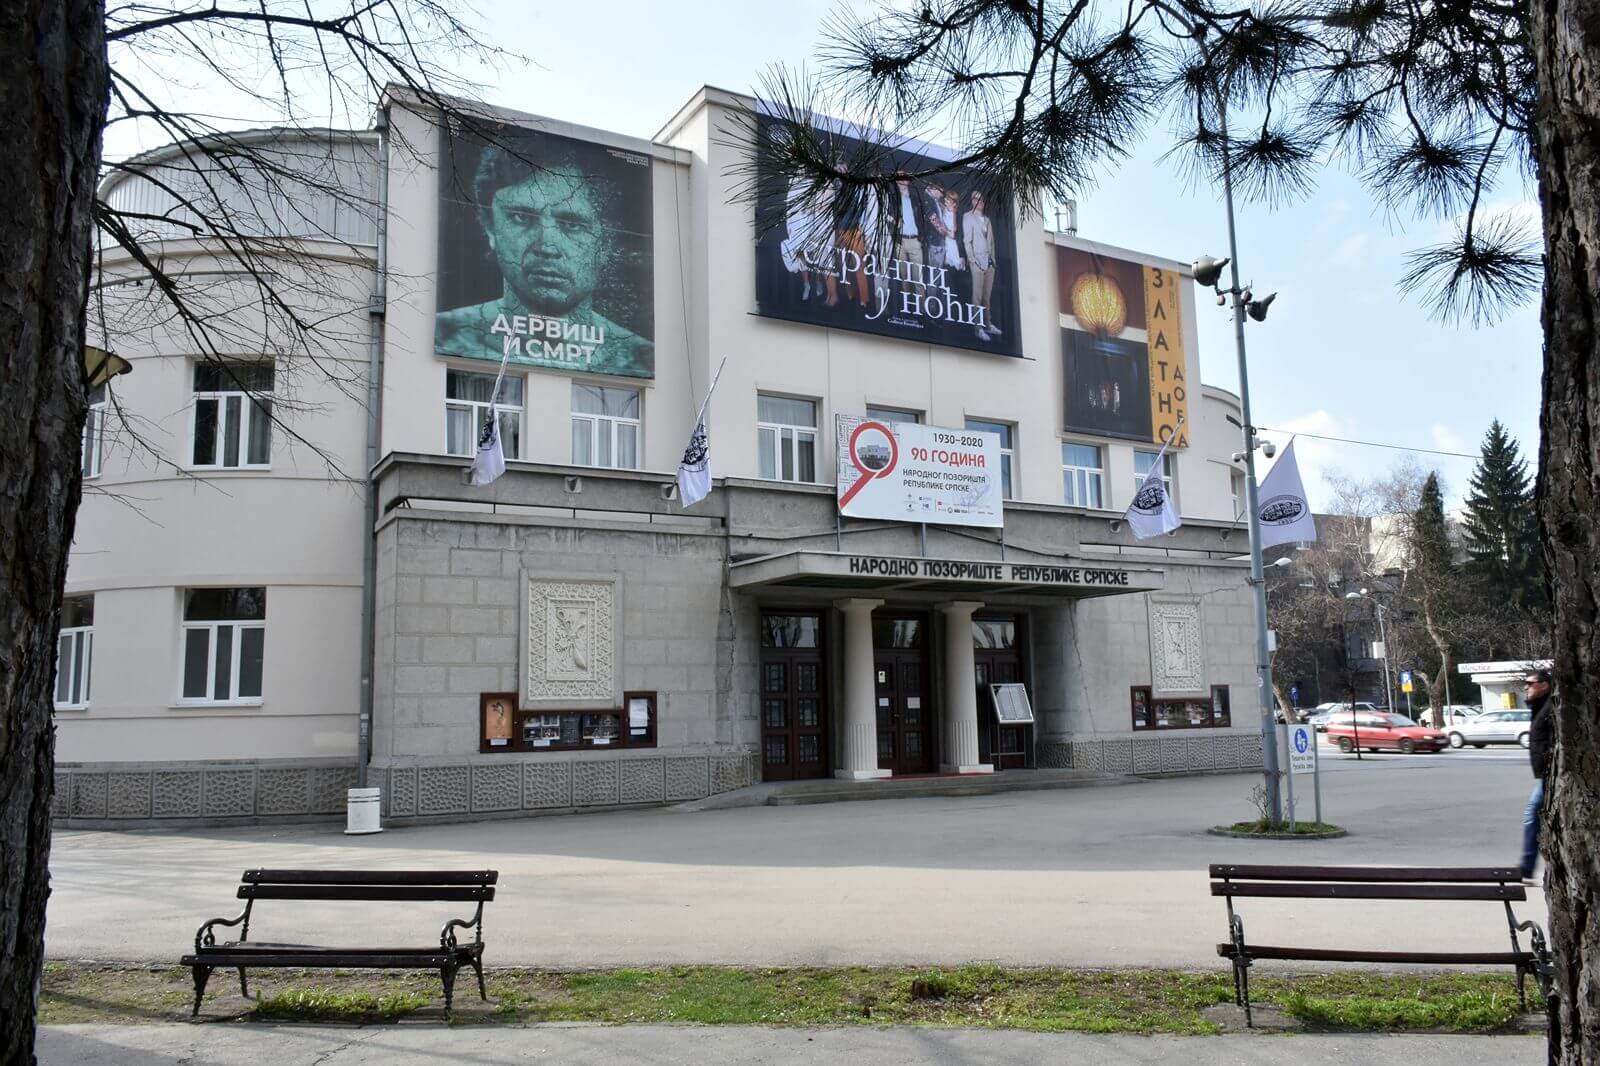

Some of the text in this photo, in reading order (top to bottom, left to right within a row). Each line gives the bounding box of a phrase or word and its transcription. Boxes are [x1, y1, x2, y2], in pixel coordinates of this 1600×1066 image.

[900, 290, 987, 328] ноћи
[491, 313, 604, 345] ДЕРВИШ
[503, 335, 521, 355] И
[525, 339, 595, 364] СМРТ
[1152, 268, 1175, 446] ЗЛАТНО
[911, 447, 985, 468] 90 ГОДИНА
[902, 469, 986, 484] НАРОДНОГ ПОЗОРИШТА
[903, 480, 970, 492] РЕПУБЛИКЕ СРПСКЕ
[850, 557, 1129, 586] НАРОДНО ПОЗОРИШТЕ РЕПУБЛИКЕ СРПСКЕ
